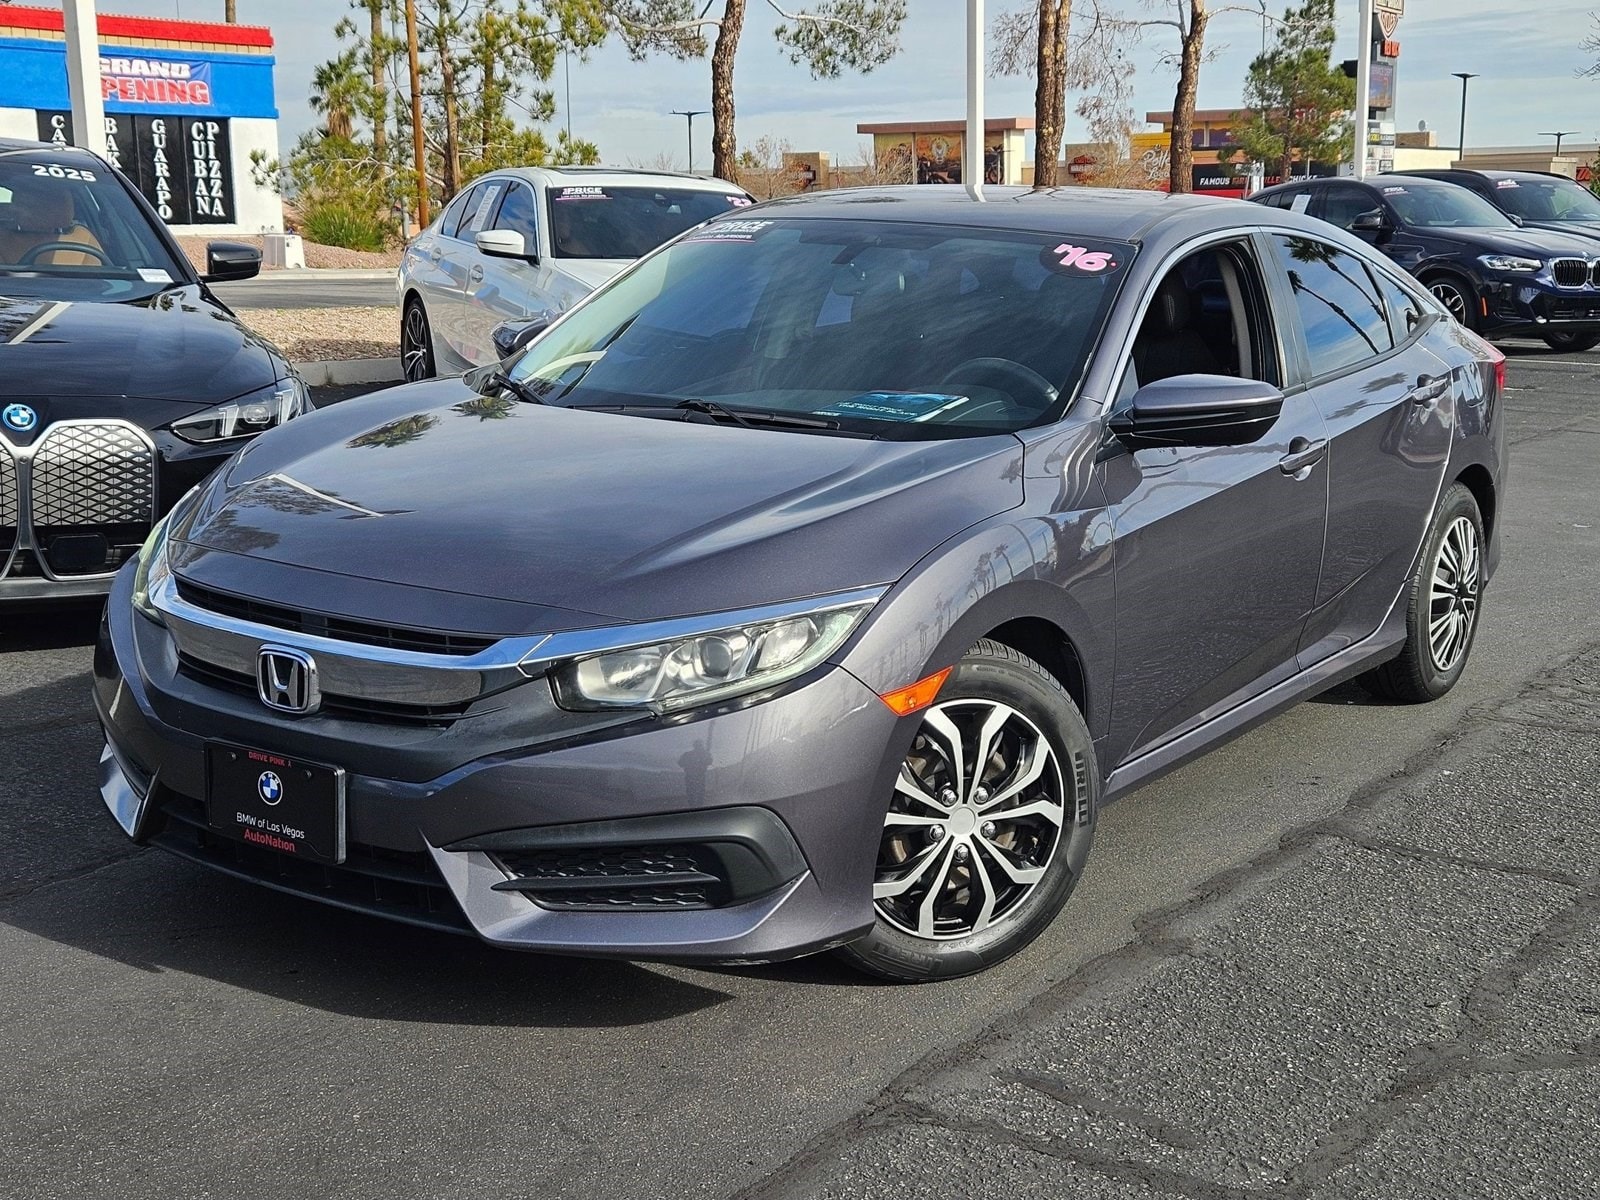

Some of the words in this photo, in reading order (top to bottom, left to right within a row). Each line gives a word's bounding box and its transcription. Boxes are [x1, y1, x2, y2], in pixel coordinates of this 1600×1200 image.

[100, 76, 210, 105] PENING
[31, 164, 97, 182] 2025
[151, 119, 173, 220] GUARAPO
[205, 122, 226, 217] PIZZA
[1200, 177, 1230, 186] FAMOUS
[248, 751, 268, 762] DRIVE
[236, 812, 256, 826] BMW
[257, 818, 266, 828] of
[266, 820, 280, 832] Los
[281, 824, 305, 839] Vegas
[244, 829, 295, 852] AutoNation
